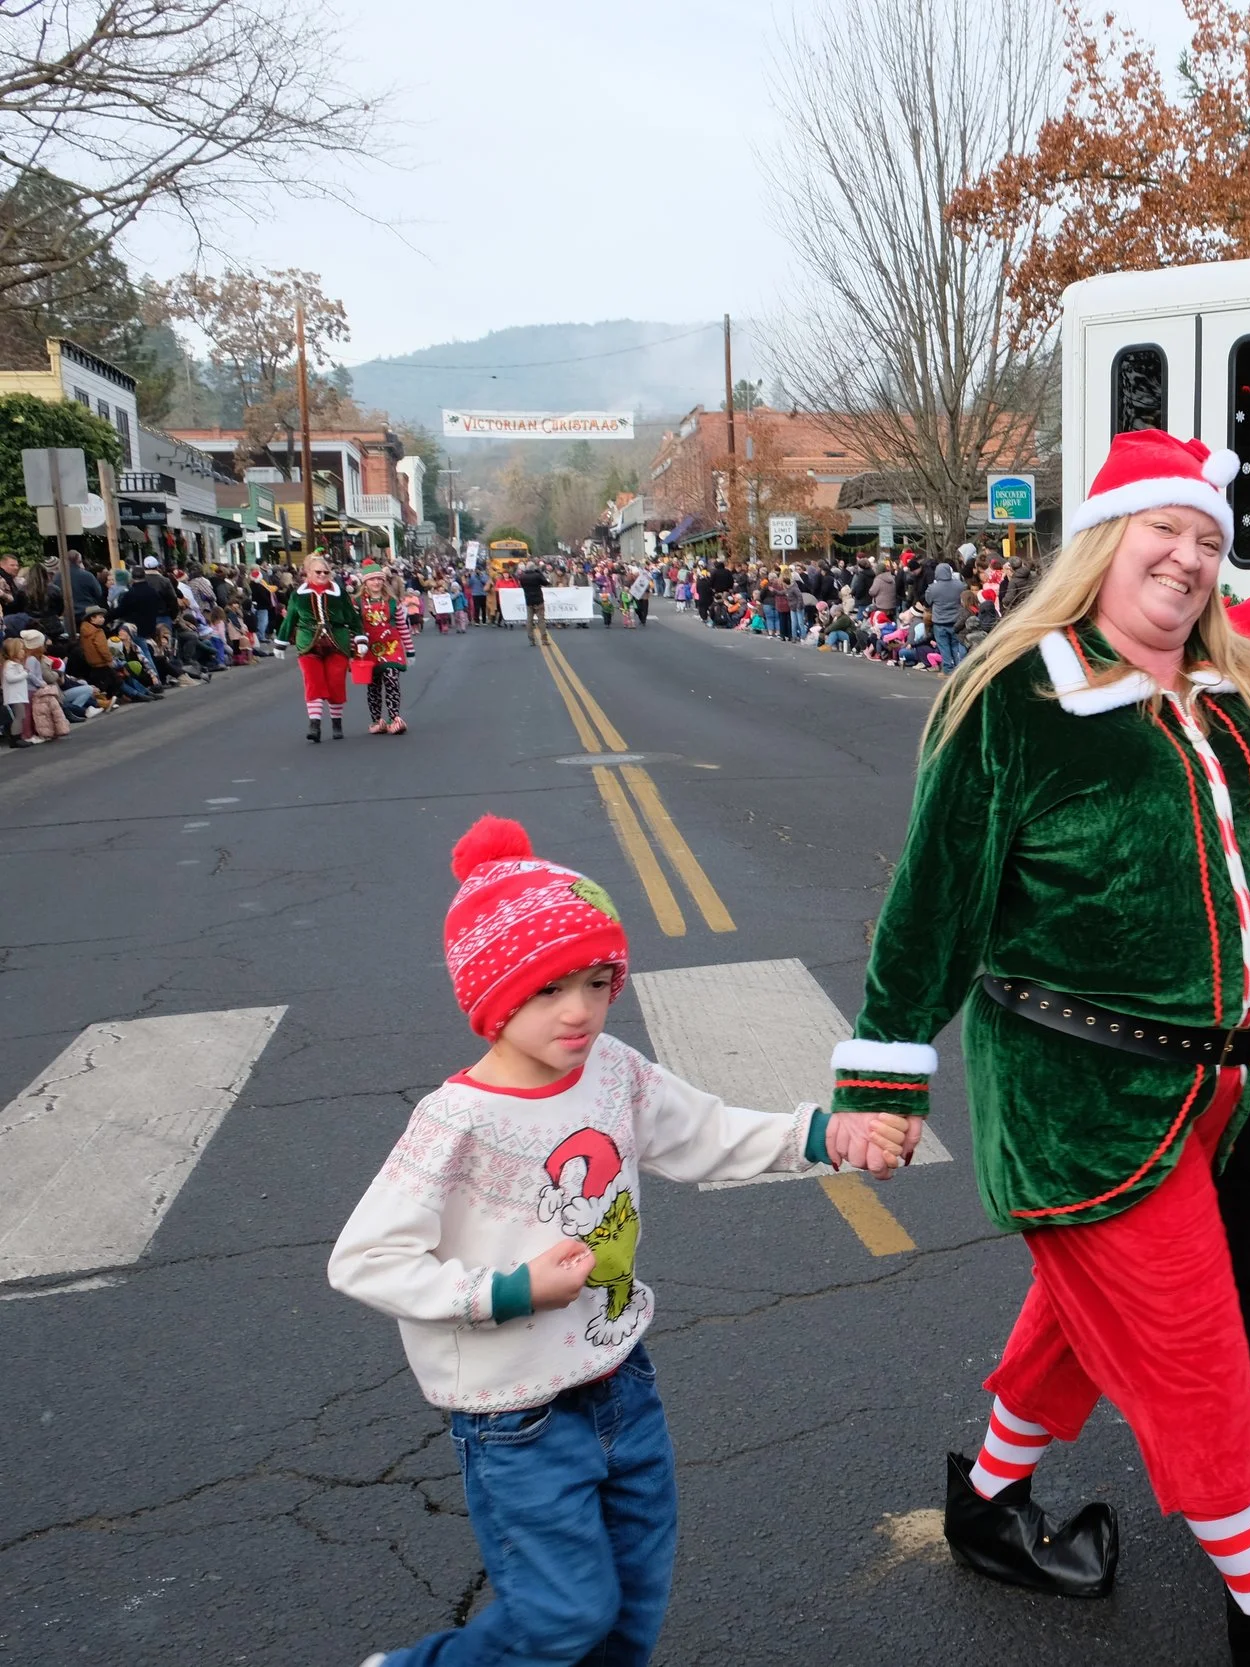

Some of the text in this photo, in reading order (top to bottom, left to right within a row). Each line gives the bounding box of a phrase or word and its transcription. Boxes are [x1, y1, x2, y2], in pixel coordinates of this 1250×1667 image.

[463, 415, 619, 434] VICTORIAN CHRISTMAS
[995, 490, 1027, 499] DISCOVERY
[773, 534, 794, 546] 20
